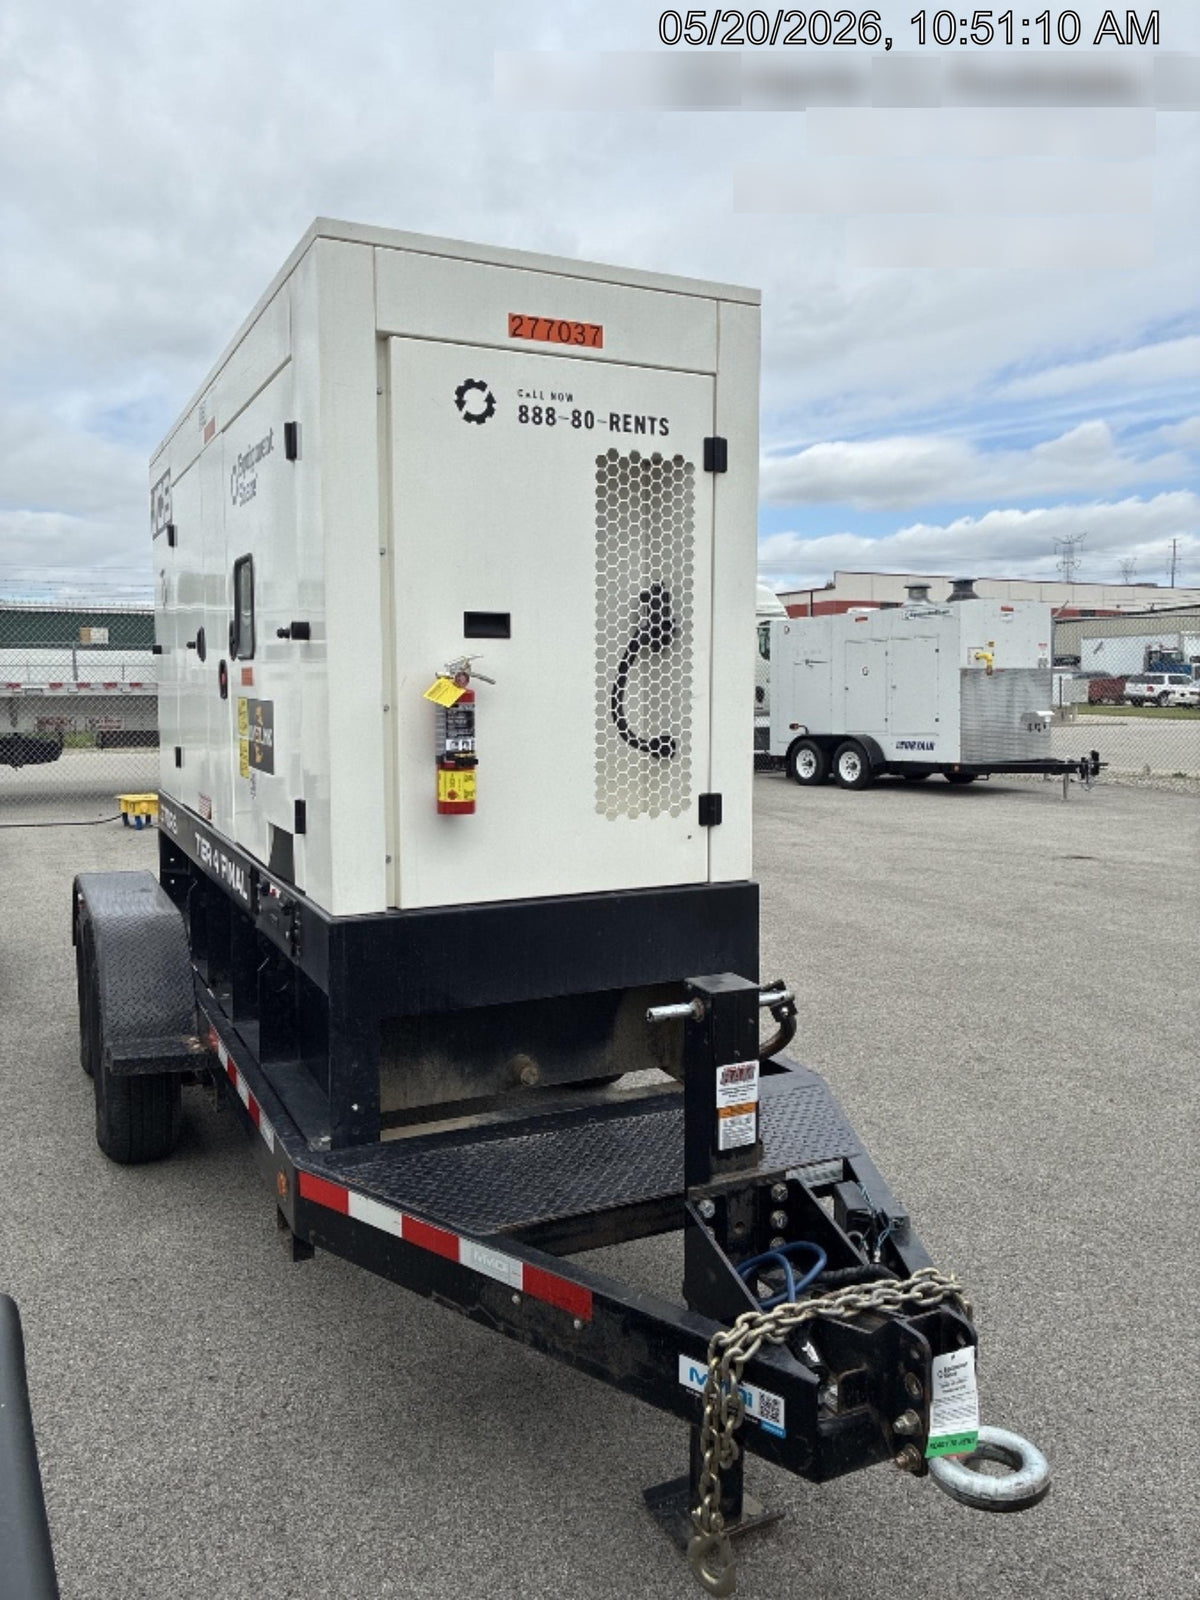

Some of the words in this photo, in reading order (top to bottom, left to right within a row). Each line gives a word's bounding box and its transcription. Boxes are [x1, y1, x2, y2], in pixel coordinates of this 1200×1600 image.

[511, 314, 601, 346] 277037
[550, 391, 574, 403] NOW
[518, 404, 670, 437] 888-80-RENTS
